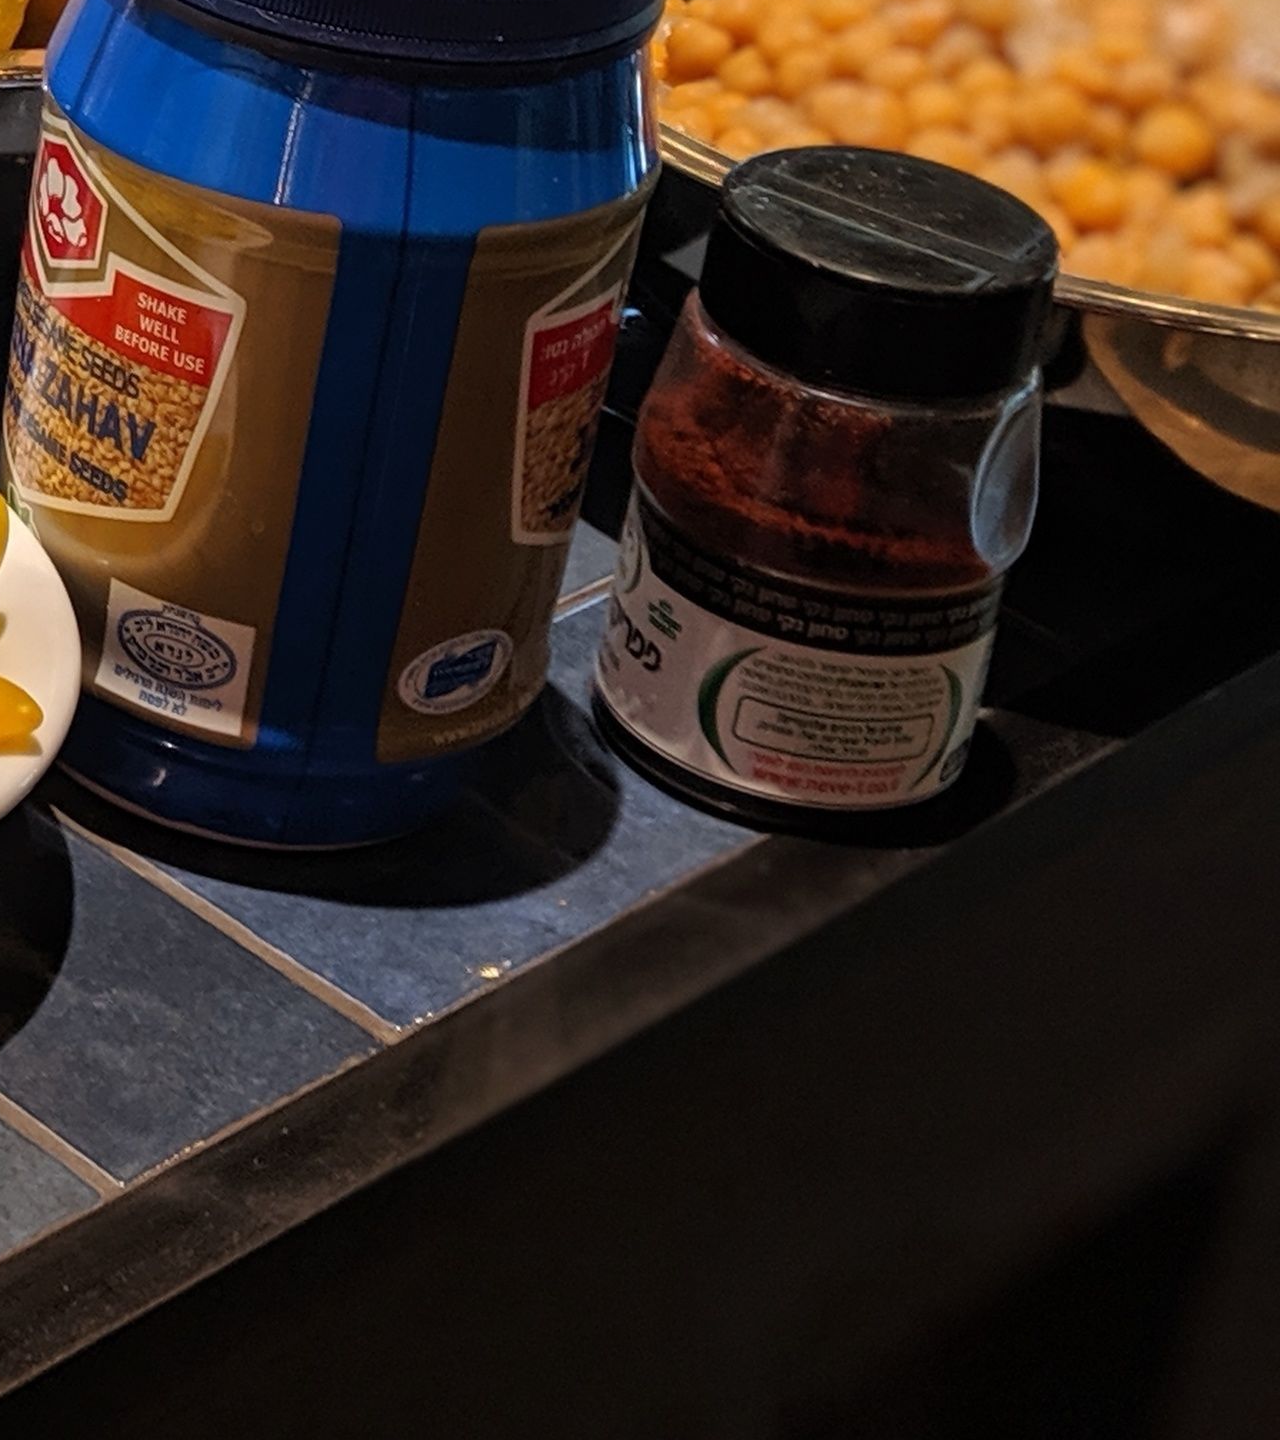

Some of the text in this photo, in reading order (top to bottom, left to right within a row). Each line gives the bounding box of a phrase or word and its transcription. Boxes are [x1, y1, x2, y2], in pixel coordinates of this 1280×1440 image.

[137, 292, 188, 325] SHAKE
[139, 315, 180, 345] WELL
[80, 345, 141, 400] SEEDS
[114, 324, 206, 375] BEFORE USE
[37, 359, 157, 461] ZAHAV
